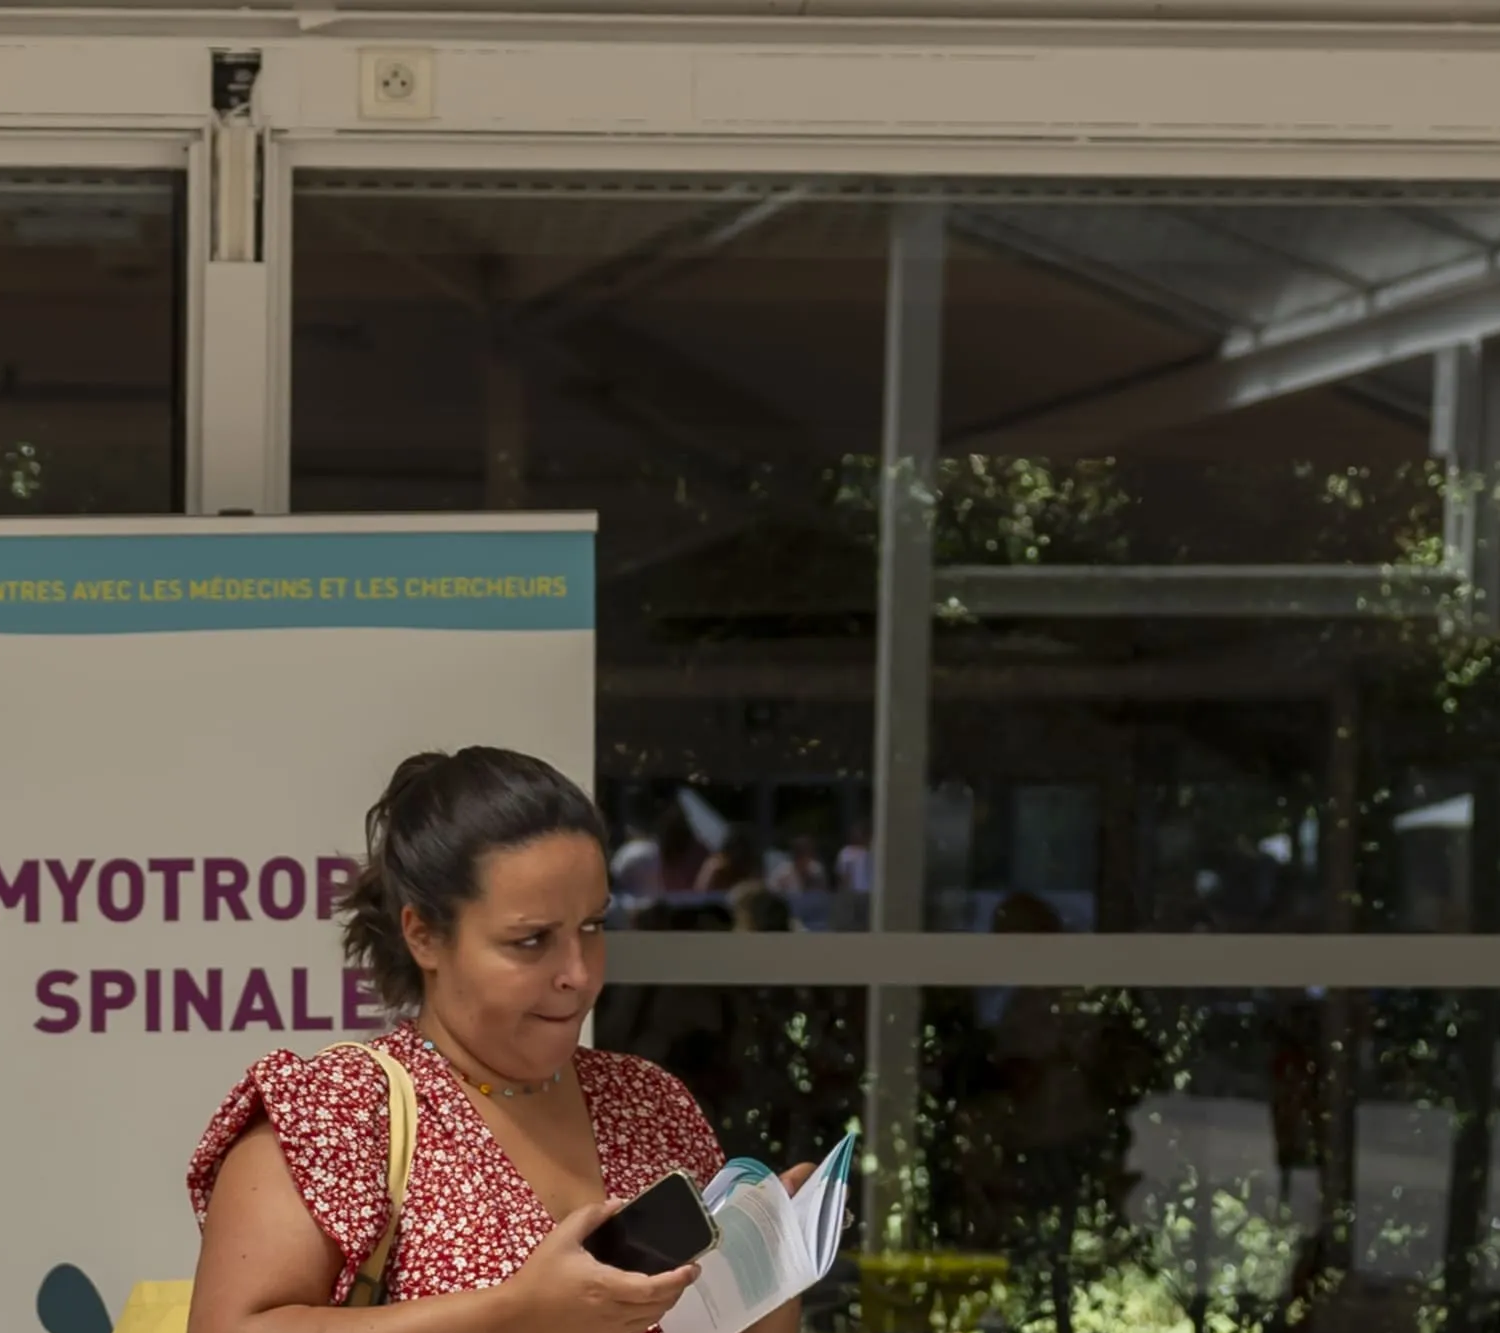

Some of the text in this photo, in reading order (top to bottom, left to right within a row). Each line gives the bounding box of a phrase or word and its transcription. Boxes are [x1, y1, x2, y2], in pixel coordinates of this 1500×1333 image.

[72, 579, 133, 601] AVEC
[138, 578, 182, 600] LES
[189, 575, 314, 600] MÉDECINS
[319, 577, 348, 599] ET
[354, 577, 399, 599] LES
[404, 575, 567, 598] CHERCHEURS
[33, 967, 386, 1034] SPINALE
